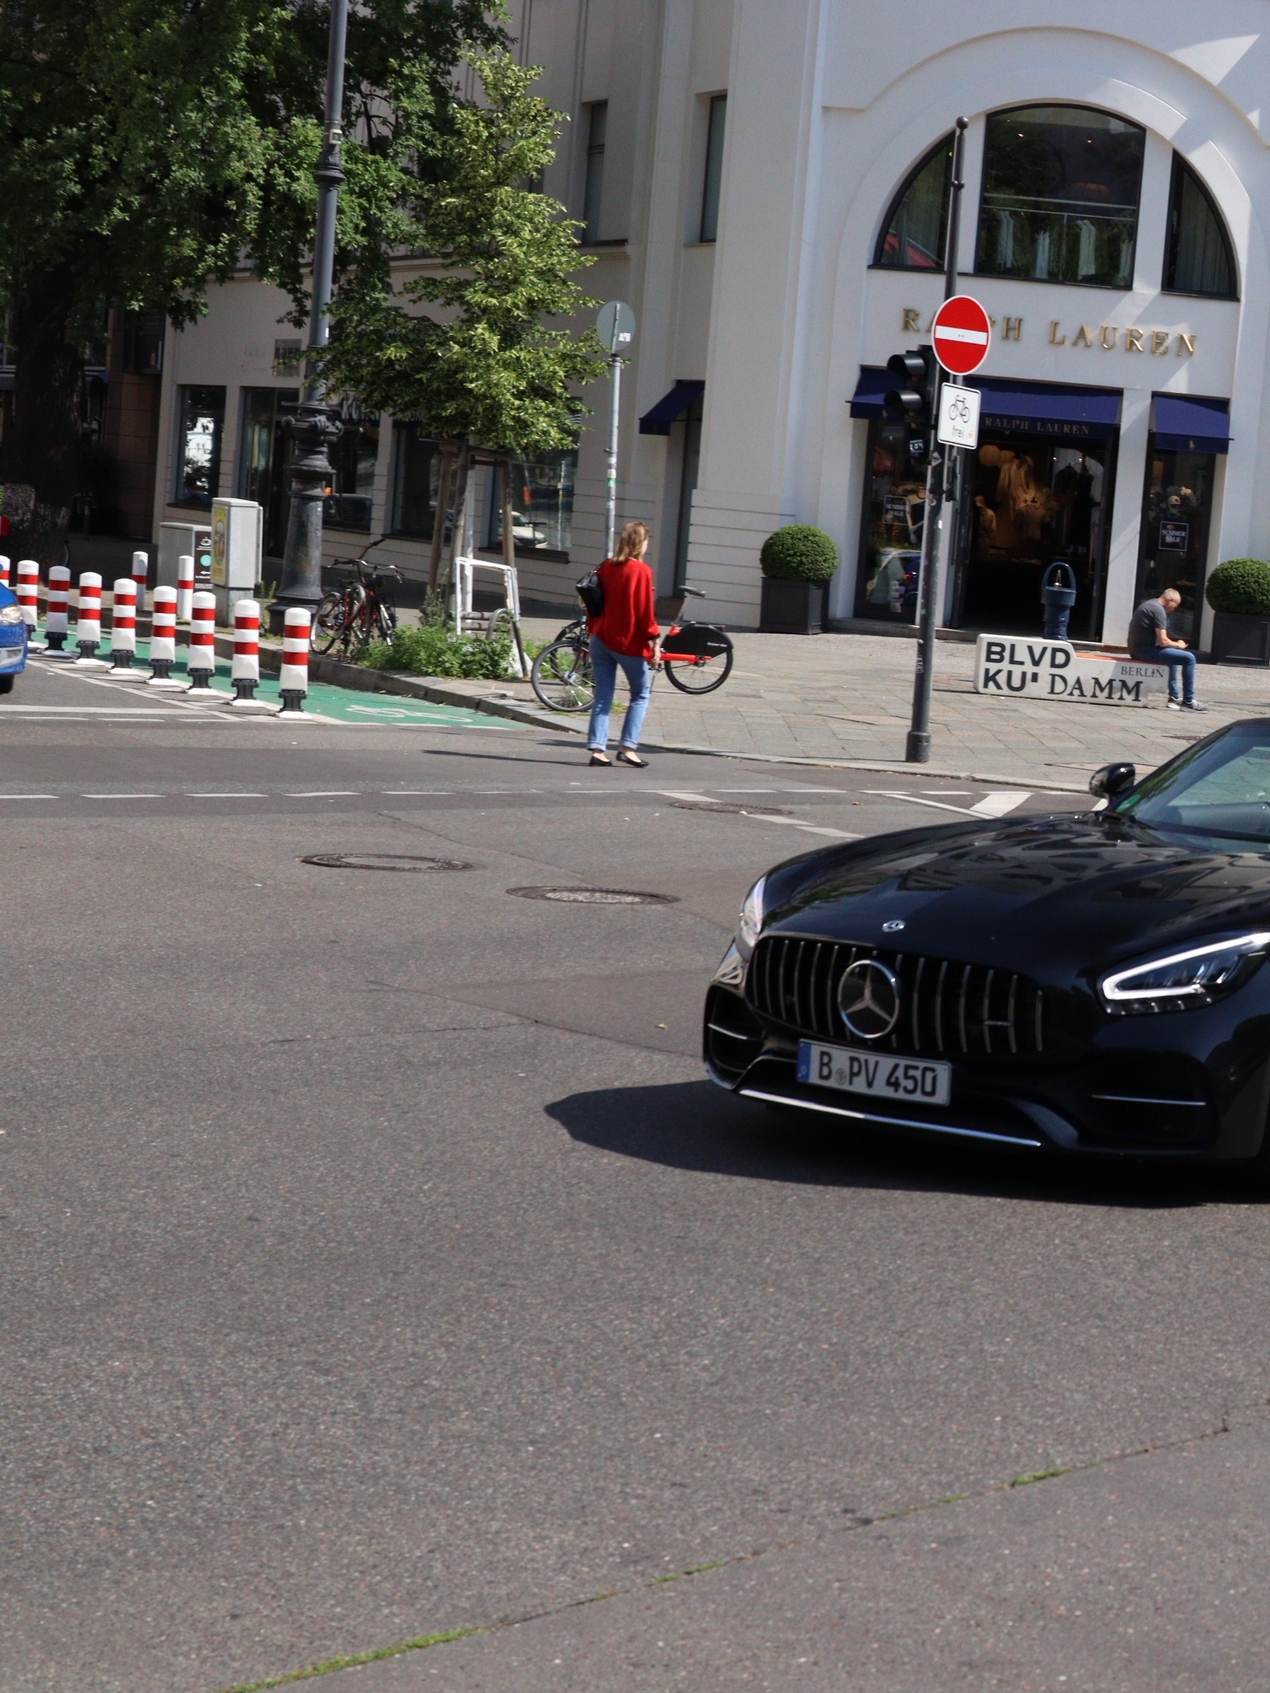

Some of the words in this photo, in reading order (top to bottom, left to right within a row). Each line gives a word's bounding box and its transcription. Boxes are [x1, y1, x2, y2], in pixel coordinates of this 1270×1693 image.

[1048, 319, 1198, 357] LAUREN
[952, 425, 965, 438] frei
[985, 416, 1029, 431] RALPH
[1037, 421, 1090, 435] LAUREN
[985, 641, 1071, 669] BLVD
[1121, 665, 1164, 679] BERLIN
[1048, 673, 1143, 702] DAMM
[818, 1051, 832, 1081] B
[849, 1056, 879, 1089] PV
[886, 1063, 937, 1097] 450
